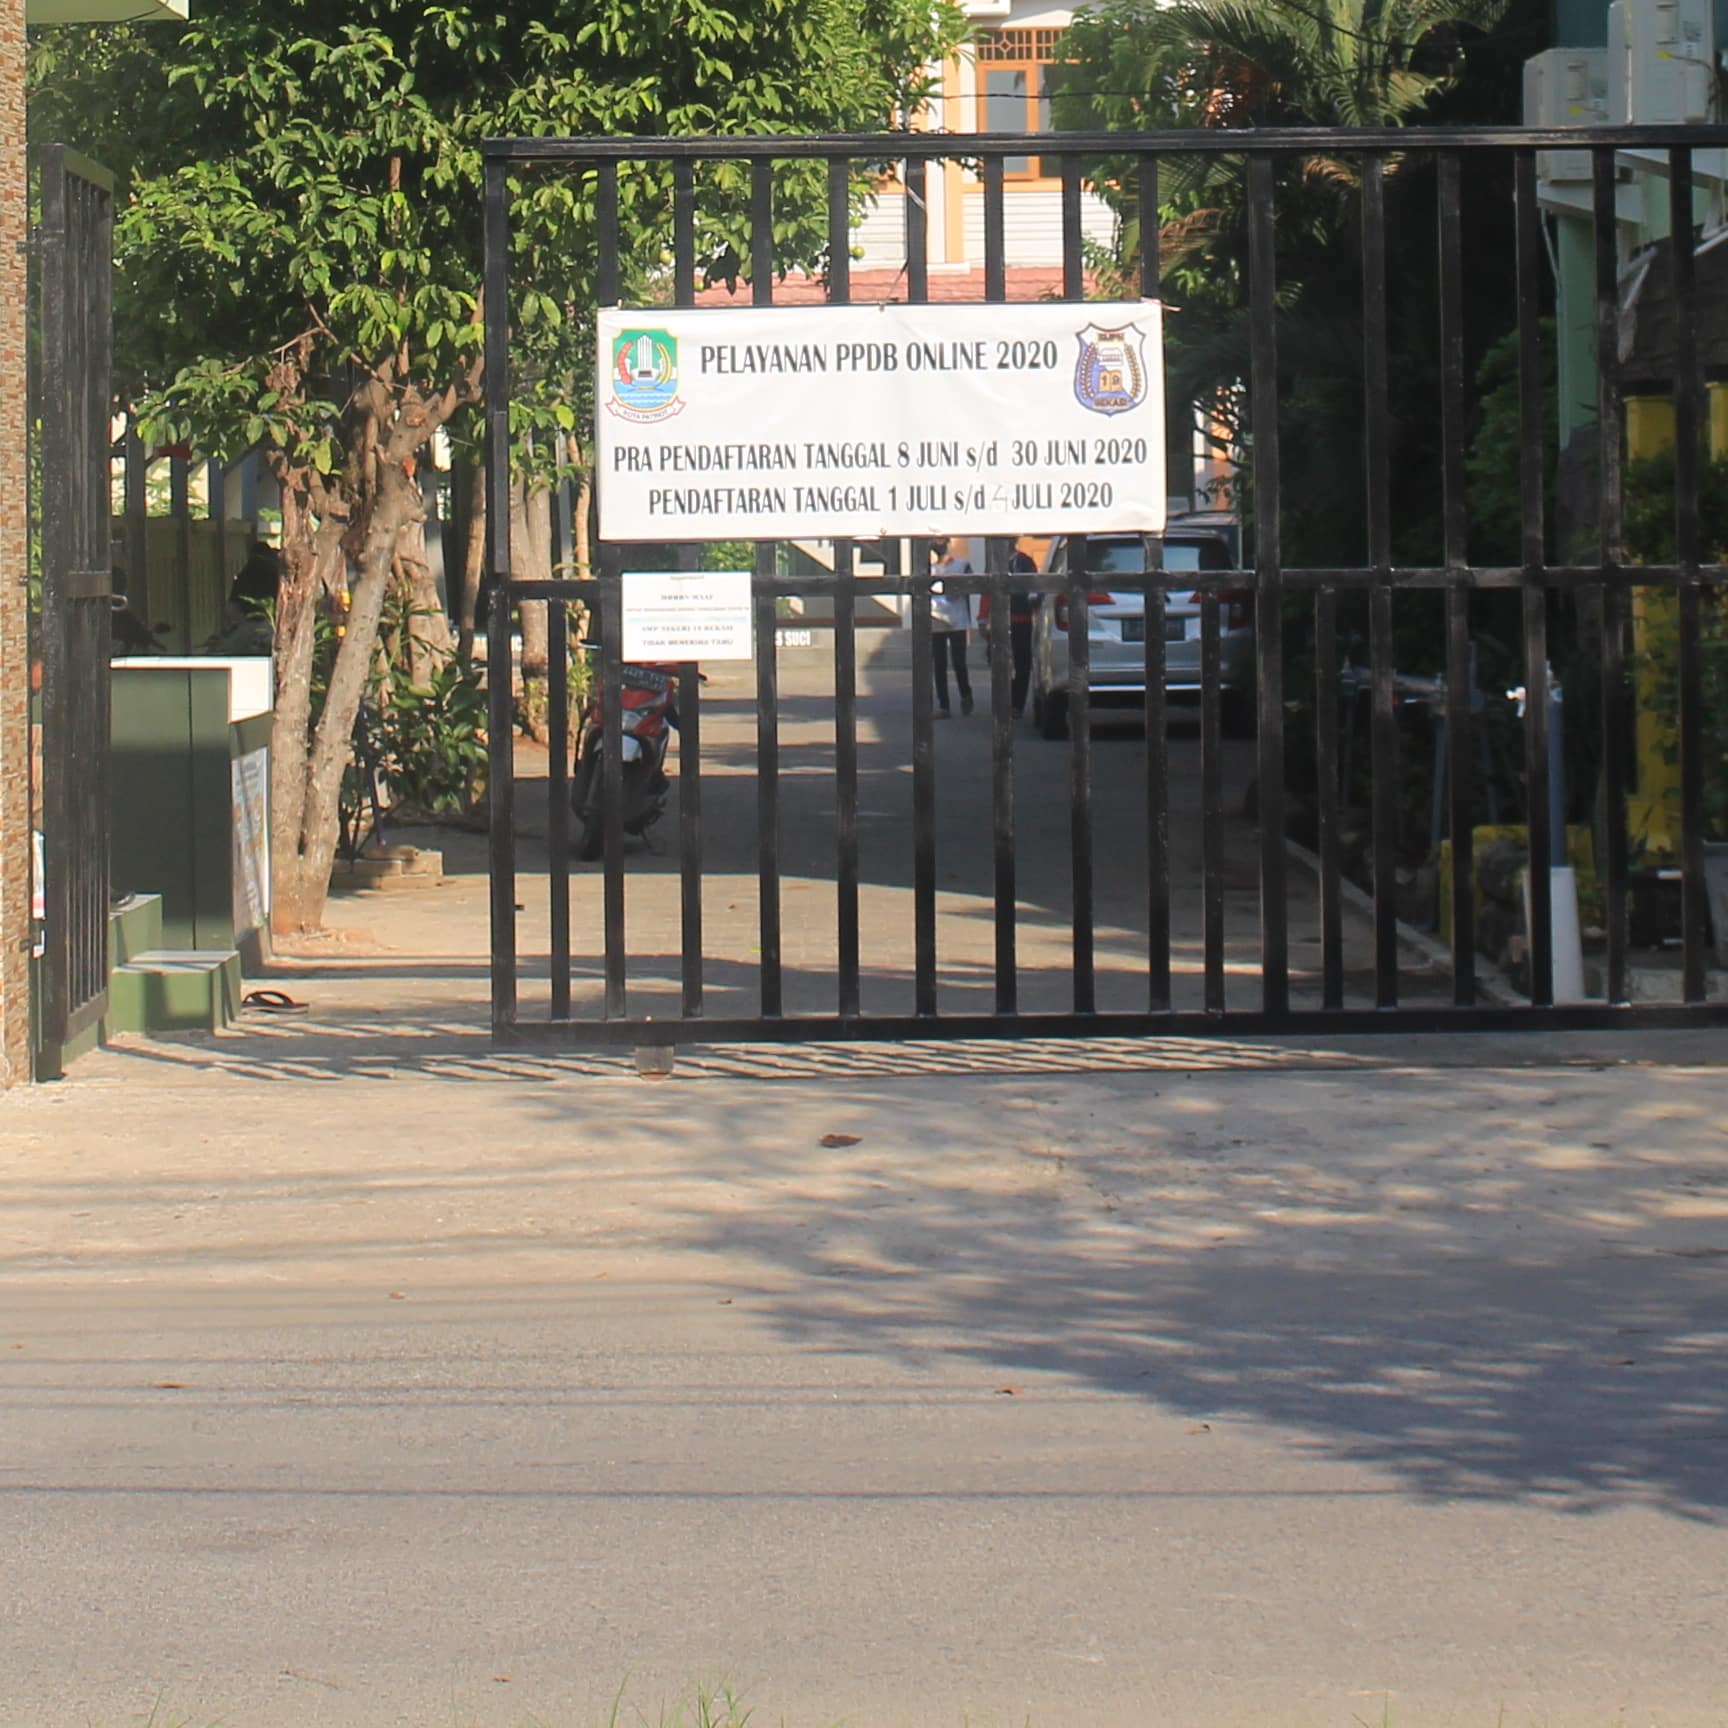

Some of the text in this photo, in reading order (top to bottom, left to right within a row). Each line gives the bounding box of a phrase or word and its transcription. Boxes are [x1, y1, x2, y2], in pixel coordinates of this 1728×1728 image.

[700, 340, 1059, 374] PELAYANAN PPDB ONLINE 2020
[613, 438, 1148, 473] PRA PENDAFTARAN TANGGAL 8 JUNI s/d 30 JUNI 2020
[648, 486, 787, 516] PENDAFTARAN
[792, 485, 880, 514] TANGGAL
[887, 485, 897, 512] 1
[905, 484, 947, 512] JULI
[954, 484, 986, 516] s/d
[1011, 483, 1053, 511] JULI
[1059, 481, 1114, 509] 2020
[785, 630, 811, 647] SUCI
